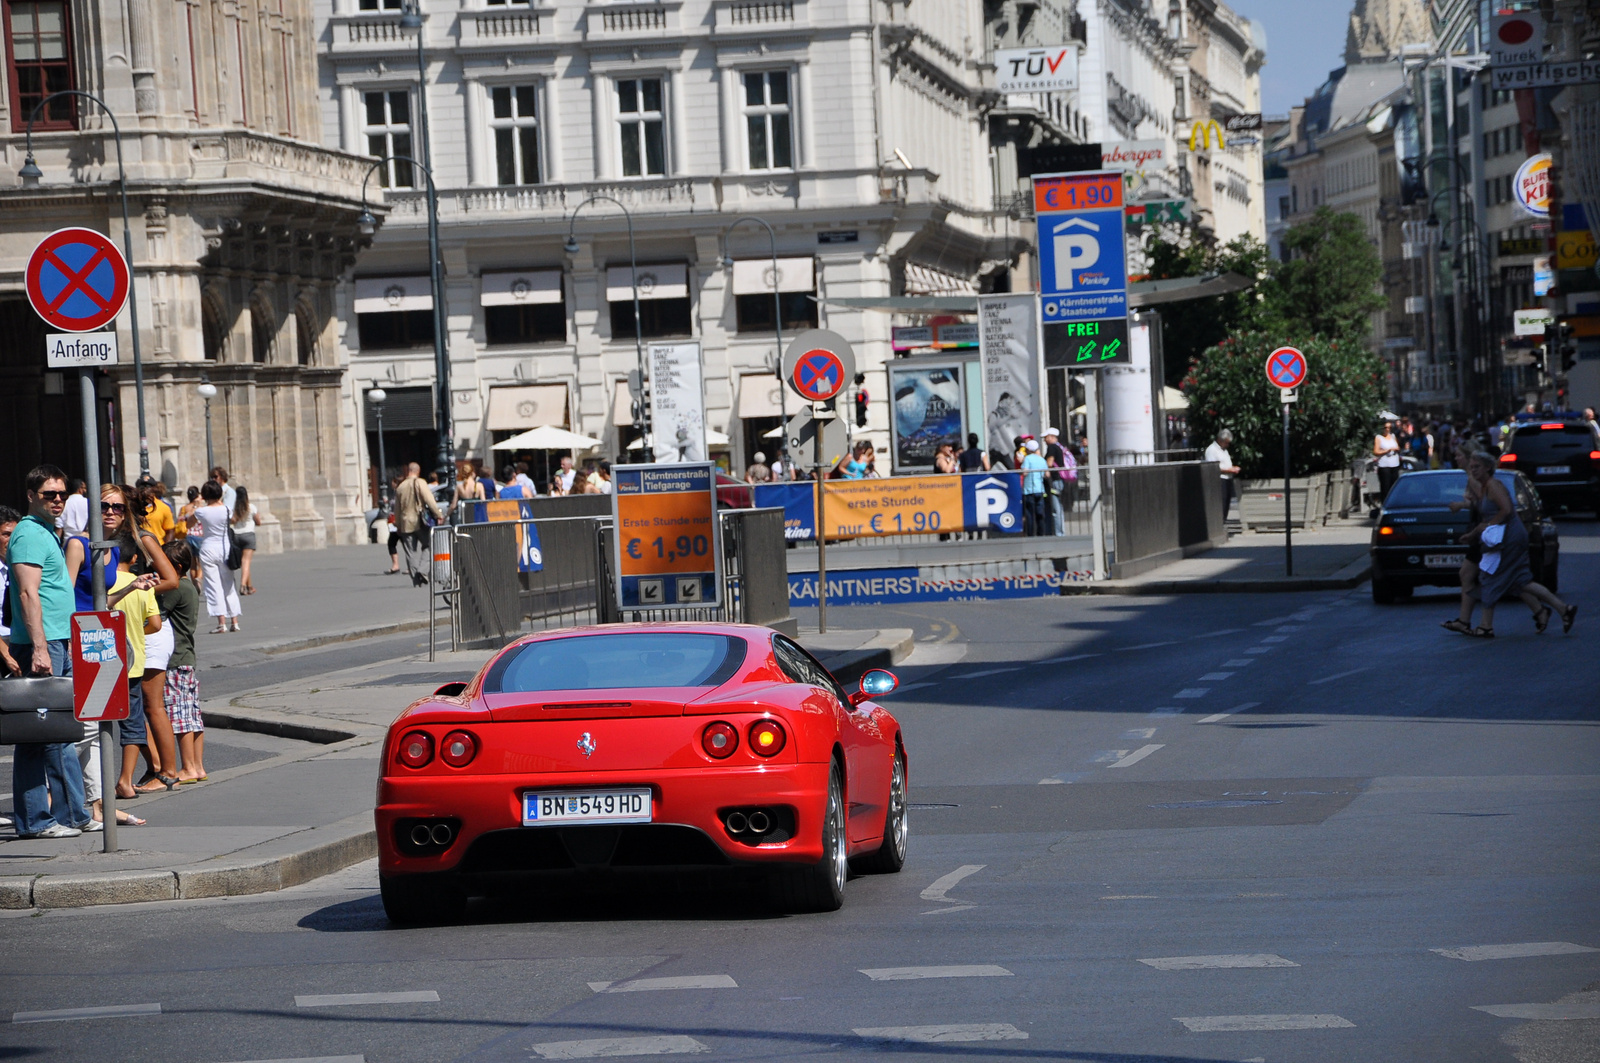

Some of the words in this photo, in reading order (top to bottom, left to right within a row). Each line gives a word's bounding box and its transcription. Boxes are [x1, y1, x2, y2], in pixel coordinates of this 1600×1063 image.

[1495, 50, 1536, 63] Turek
[1045, 188, 1059, 207] €
[1067, 185, 1113, 208] 1,90
[1053, 234, 1100, 291] P
[1060, 295, 1124, 307] Kärntnerstraße
[1060, 307, 1107, 317] Staatsoper
[1067, 322, 1099, 336] FREI
[55, 339, 108, 361] Anfang
[644, 470, 709, 480] Kärntnerstraße
[645, 481, 691, 491] Tiefgarage
[848, 498, 878, 509] erste
[882, 496, 925, 507] Stunde
[975, 488, 1009, 527] P
[623, 519, 650, 527] Erste
[653, 516, 690, 526] Stunde
[693, 516, 710, 524] nur
[838, 524, 864, 535] nur
[870, 513, 884, 533] €
[626, 538, 642, 559] €
[652, 534, 708, 563] 1,90
[542, 797, 565, 815] BN
[580, 796, 615, 814] 549
[619, 795, 642, 813] HD
